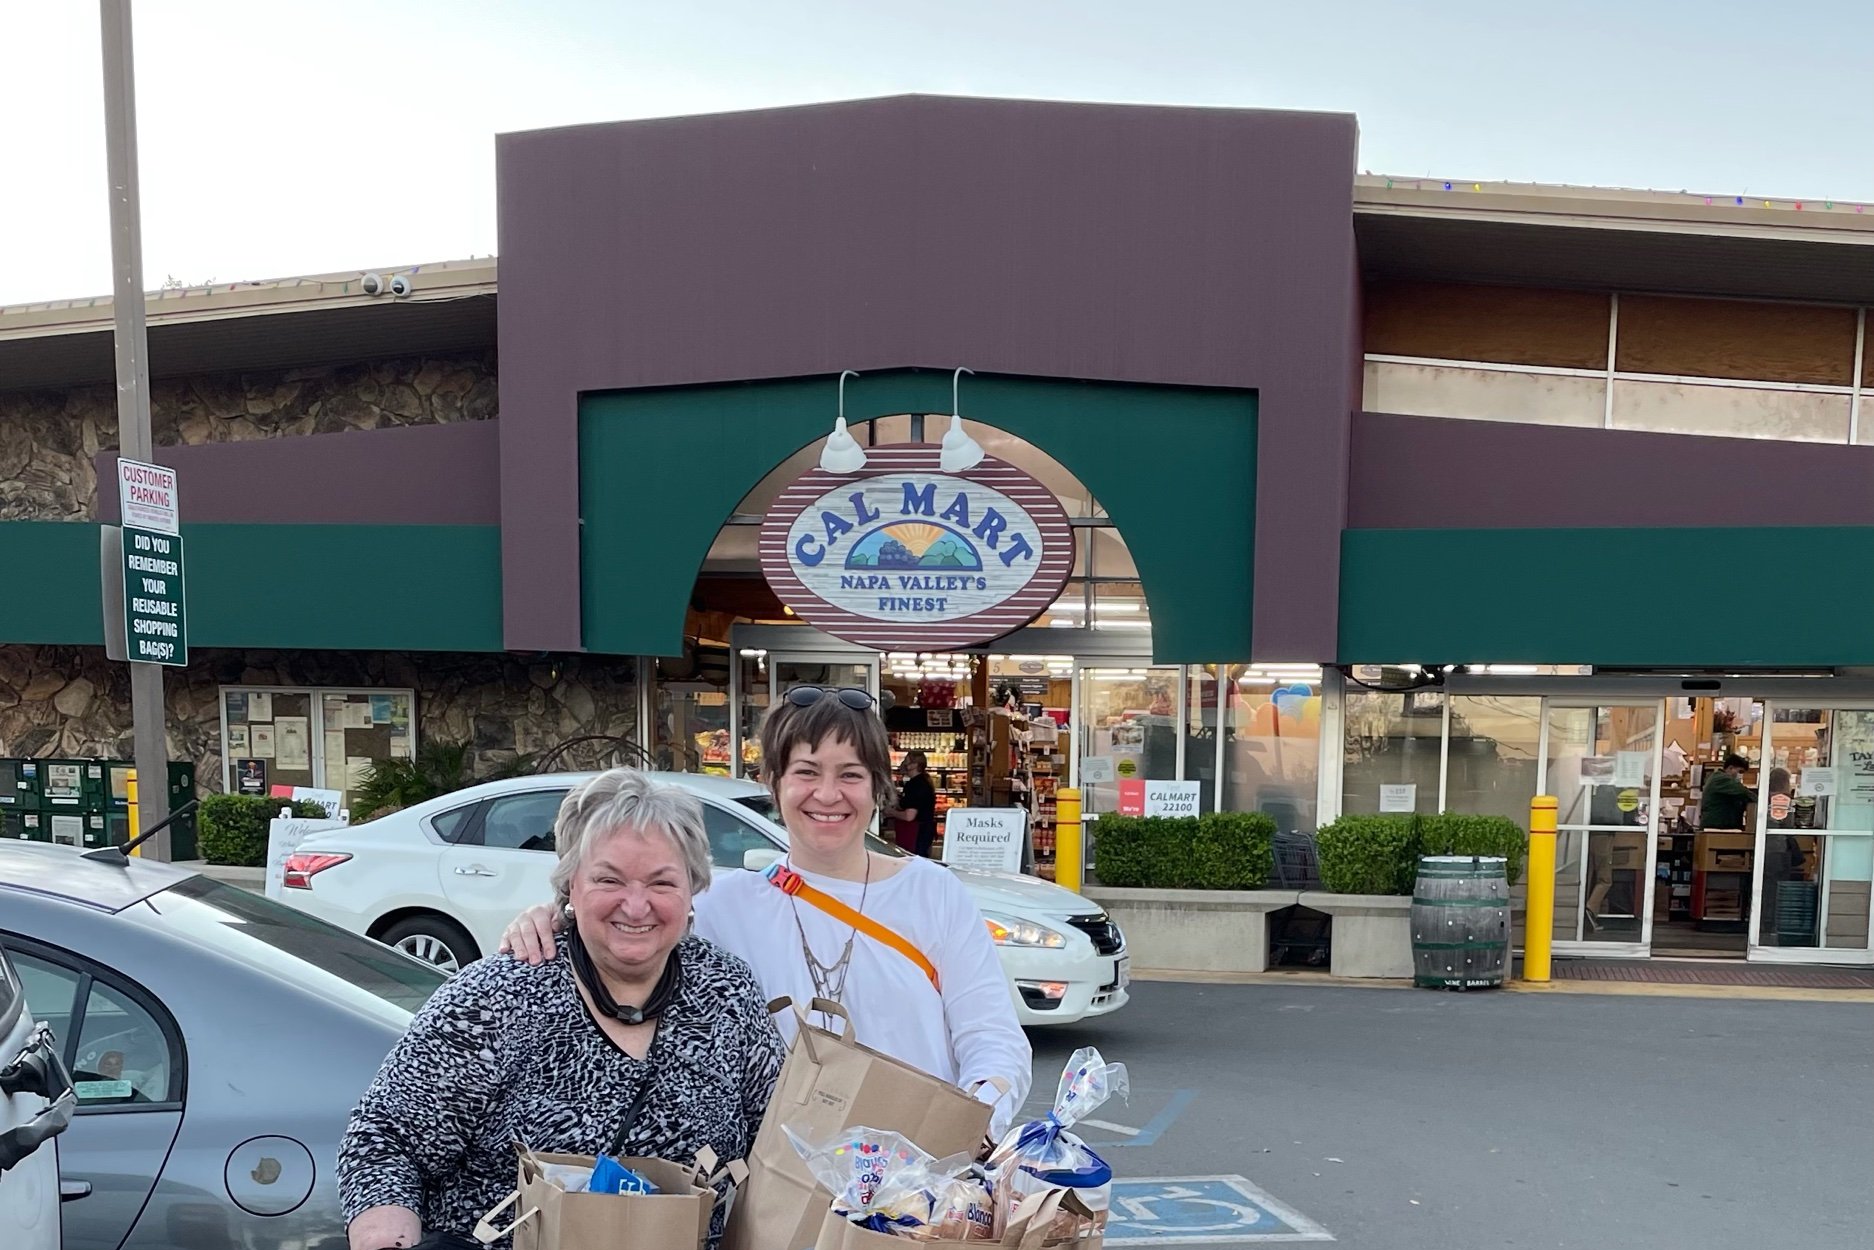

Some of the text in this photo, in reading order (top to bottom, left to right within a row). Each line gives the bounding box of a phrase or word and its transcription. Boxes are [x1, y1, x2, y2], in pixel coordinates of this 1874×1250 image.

[123, 466, 173, 491] CUSTOMER
[130, 486, 170, 507] PARKING
[795, 482, 1033, 567] CAL MART
[134, 534, 170, 554] DID YOU
[128, 554, 178, 576] REMEMBER
[141, 577, 166, 595] YOUR
[841, 575, 987, 591] NAPA VALLEY'S
[132, 598, 178, 617] REUSABLE
[878, 597, 948, 612] FINEST
[133, 618, 178, 638] SHOPPING
[139, 639, 174, 660] BAG(S)?
[1150, 792, 1197, 802] CALMART
[1162, 803, 1193, 812] 22100
[965, 817, 1004, 829] Masks
[956, 831, 1011, 845] Required
